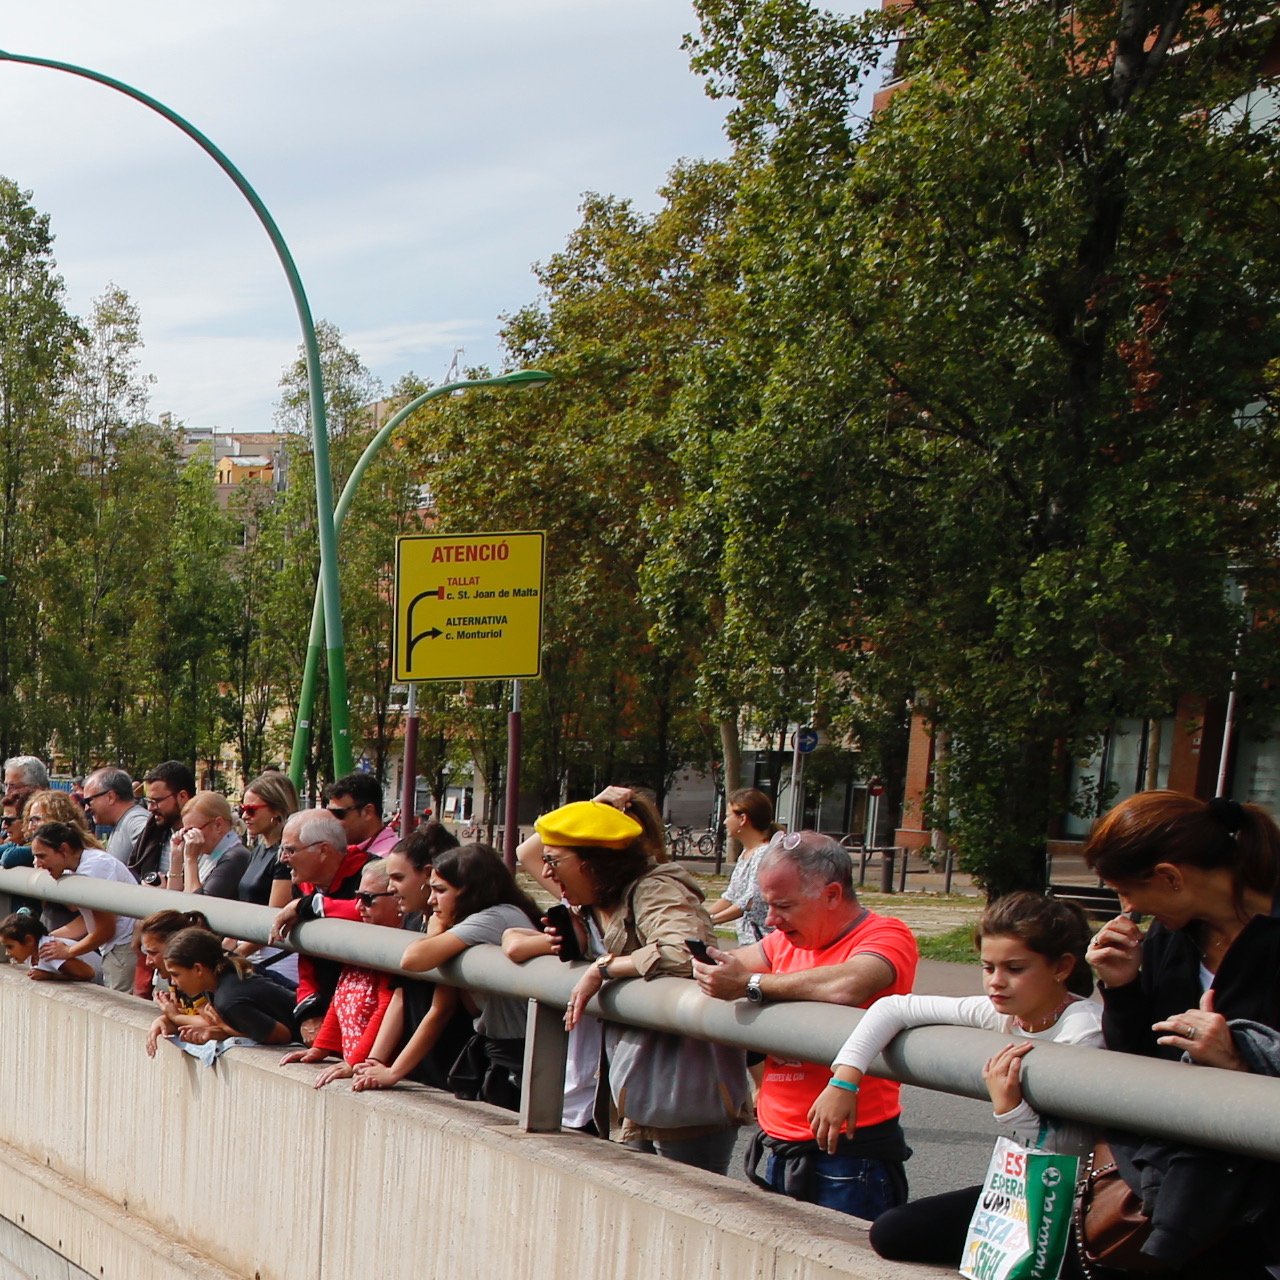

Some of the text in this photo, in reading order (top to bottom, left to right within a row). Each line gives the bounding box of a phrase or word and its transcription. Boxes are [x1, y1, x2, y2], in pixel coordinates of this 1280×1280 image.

[431, 540, 510, 563] ATENCIÓ
[447, 577, 481, 586] TALLAT
[446, 587, 539, 600] c. St. Joan de Malta
[446, 615, 508, 627] ALTERNATIVA
[445, 629, 502, 640] c. Monturiol
[1005, 1152, 1027, 1177] ES
[990, 1173, 1027, 1201] ESPERA
[983, 1191, 1011, 1216] UNA
[973, 1211, 1015, 1246] ESTA
